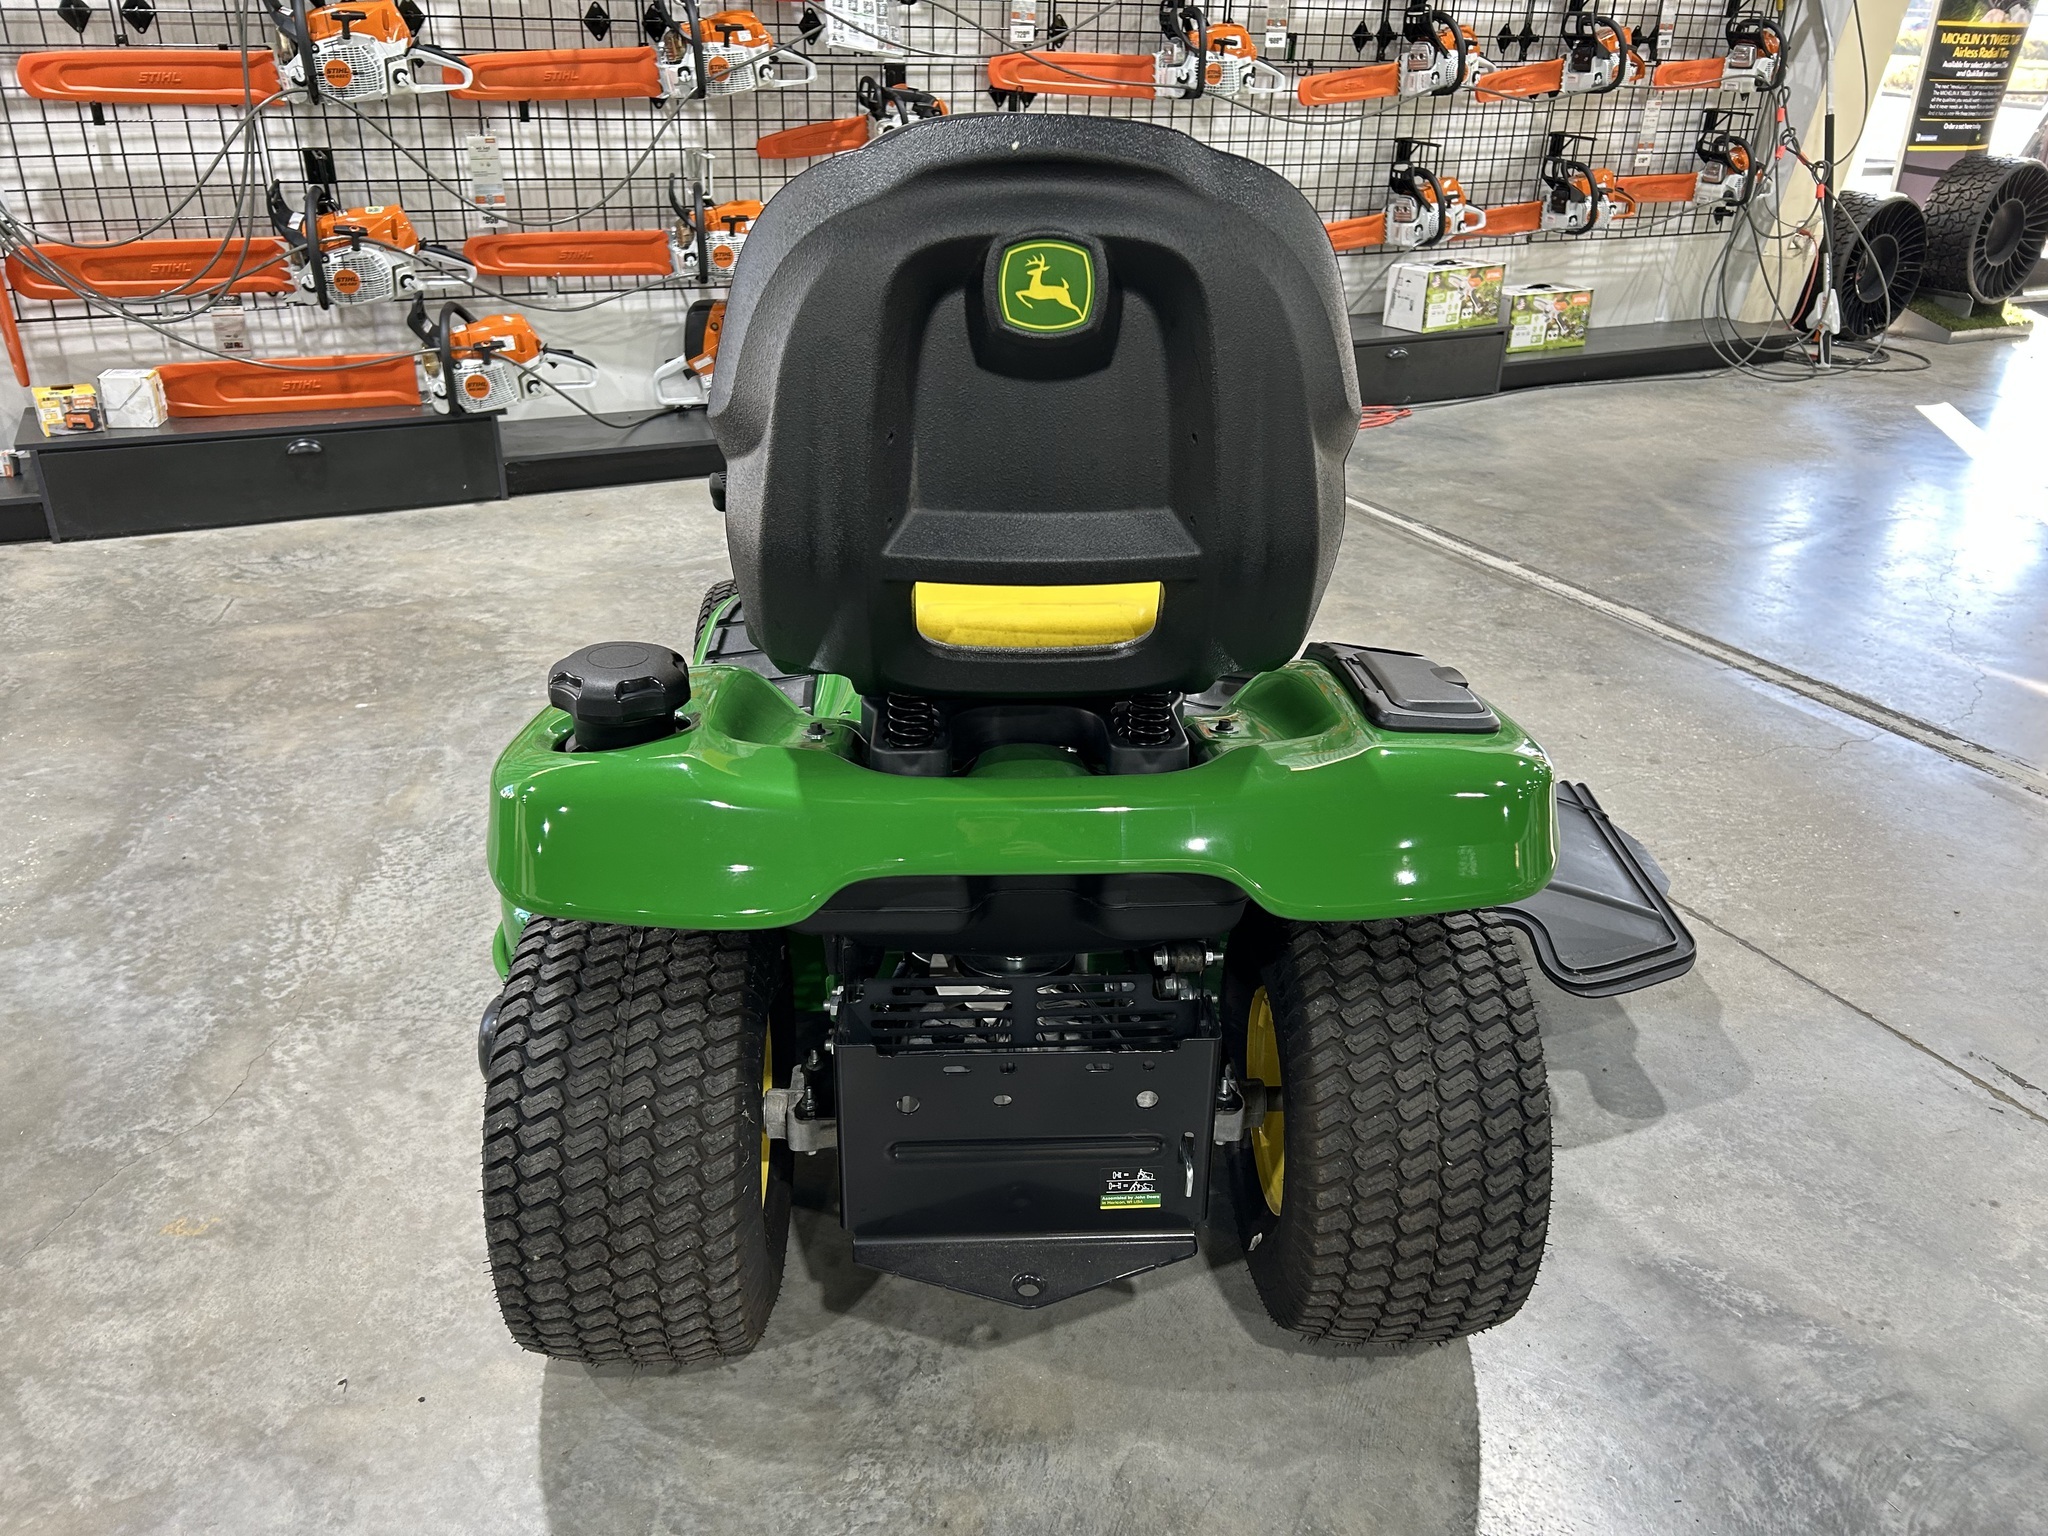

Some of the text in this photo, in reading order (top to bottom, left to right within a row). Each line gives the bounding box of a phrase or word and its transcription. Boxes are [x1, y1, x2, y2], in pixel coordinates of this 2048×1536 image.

[1941, 32, 1981, 44] MICHELIN
[1980, 33, 1988, 44] X
[1952, 46, 1978, 58] Airless
[139, 71, 181, 82] STIHL
[544, 70, 579, 81] STIHL
[559, 250, 594, 260] STIHL
[150, 262, 191, 273] STIHL
[282, 379, 321, 390] STIHL
